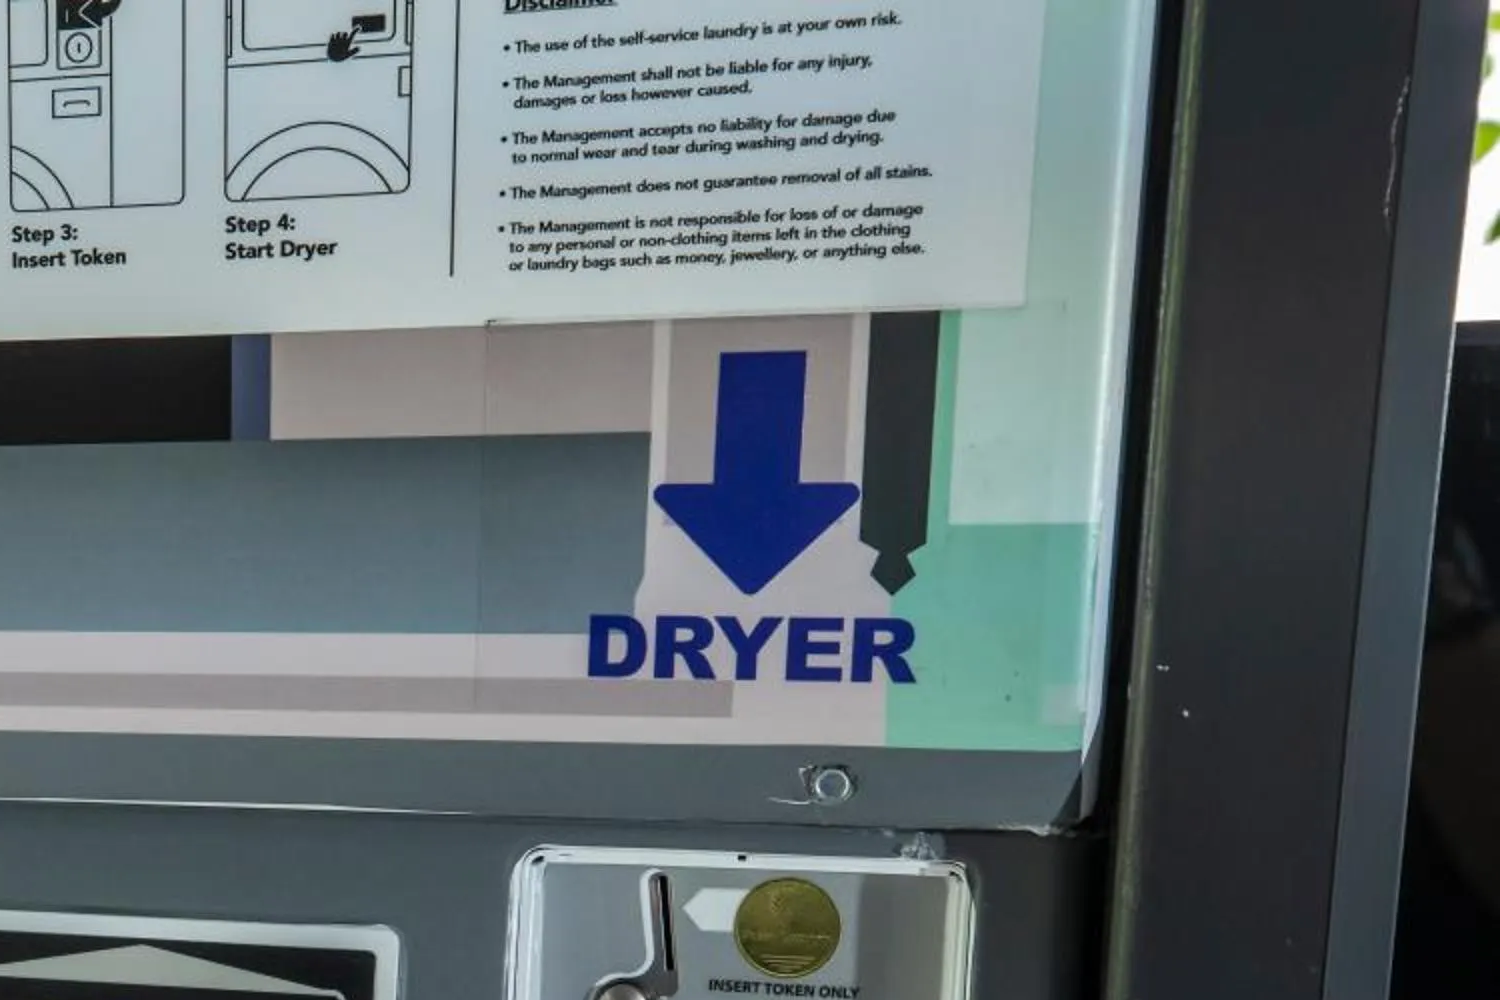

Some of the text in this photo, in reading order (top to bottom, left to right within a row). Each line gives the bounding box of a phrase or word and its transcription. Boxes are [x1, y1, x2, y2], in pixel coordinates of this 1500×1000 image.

[514, 10, 902, 54] The use of the self-service laundry is at your own risk.
[513, 76, 540, 90] The
[543, 70, 636, 89] Management
[640, 65, 673, 81] shall
[676, 66, 701, 79] not
[705, 63, 725, 77] be
[728, 59, 769, 75] liable
[772, 57, 794, 72] for
[797, 59, 825, 73] any
[513, 79, 753, 111] damages or loss however caused.
[512, 108, 897, 145] The Management accepts no liability for damage due
[512, 130, 884, 164] to normal wear and tear during washing and drying.
[510, 164, 933, 200] The Management does not guarantee removal of all stains.
[12, 223, 78, 247] Step 3:
[225, 213, 295, 237] Step 4:
[510, 203, 924, 235] The Management is not responsible for loss of or damage
[225, 239, 338, 262] Start Dryer
[509, 222, 911, 255] to any personal or non-clothing items left in the clothing
[12, 247, 127, 269] Insert Token
[508, 261, 524, 271] or
[527, 256, 579, 273] laundry
[582, 255, 617, 271] bags
[620, 252, 653, 267] such
[655, 255, 672, 265] as
[802, 249, 819, 259] or
[822, 242, 887, 261] anything
[891, 240, 925, 255] else.
[587, 613, 917, 684] DRYER
[708, 979, 861, 1000] INSERT TOKEN ONLY
